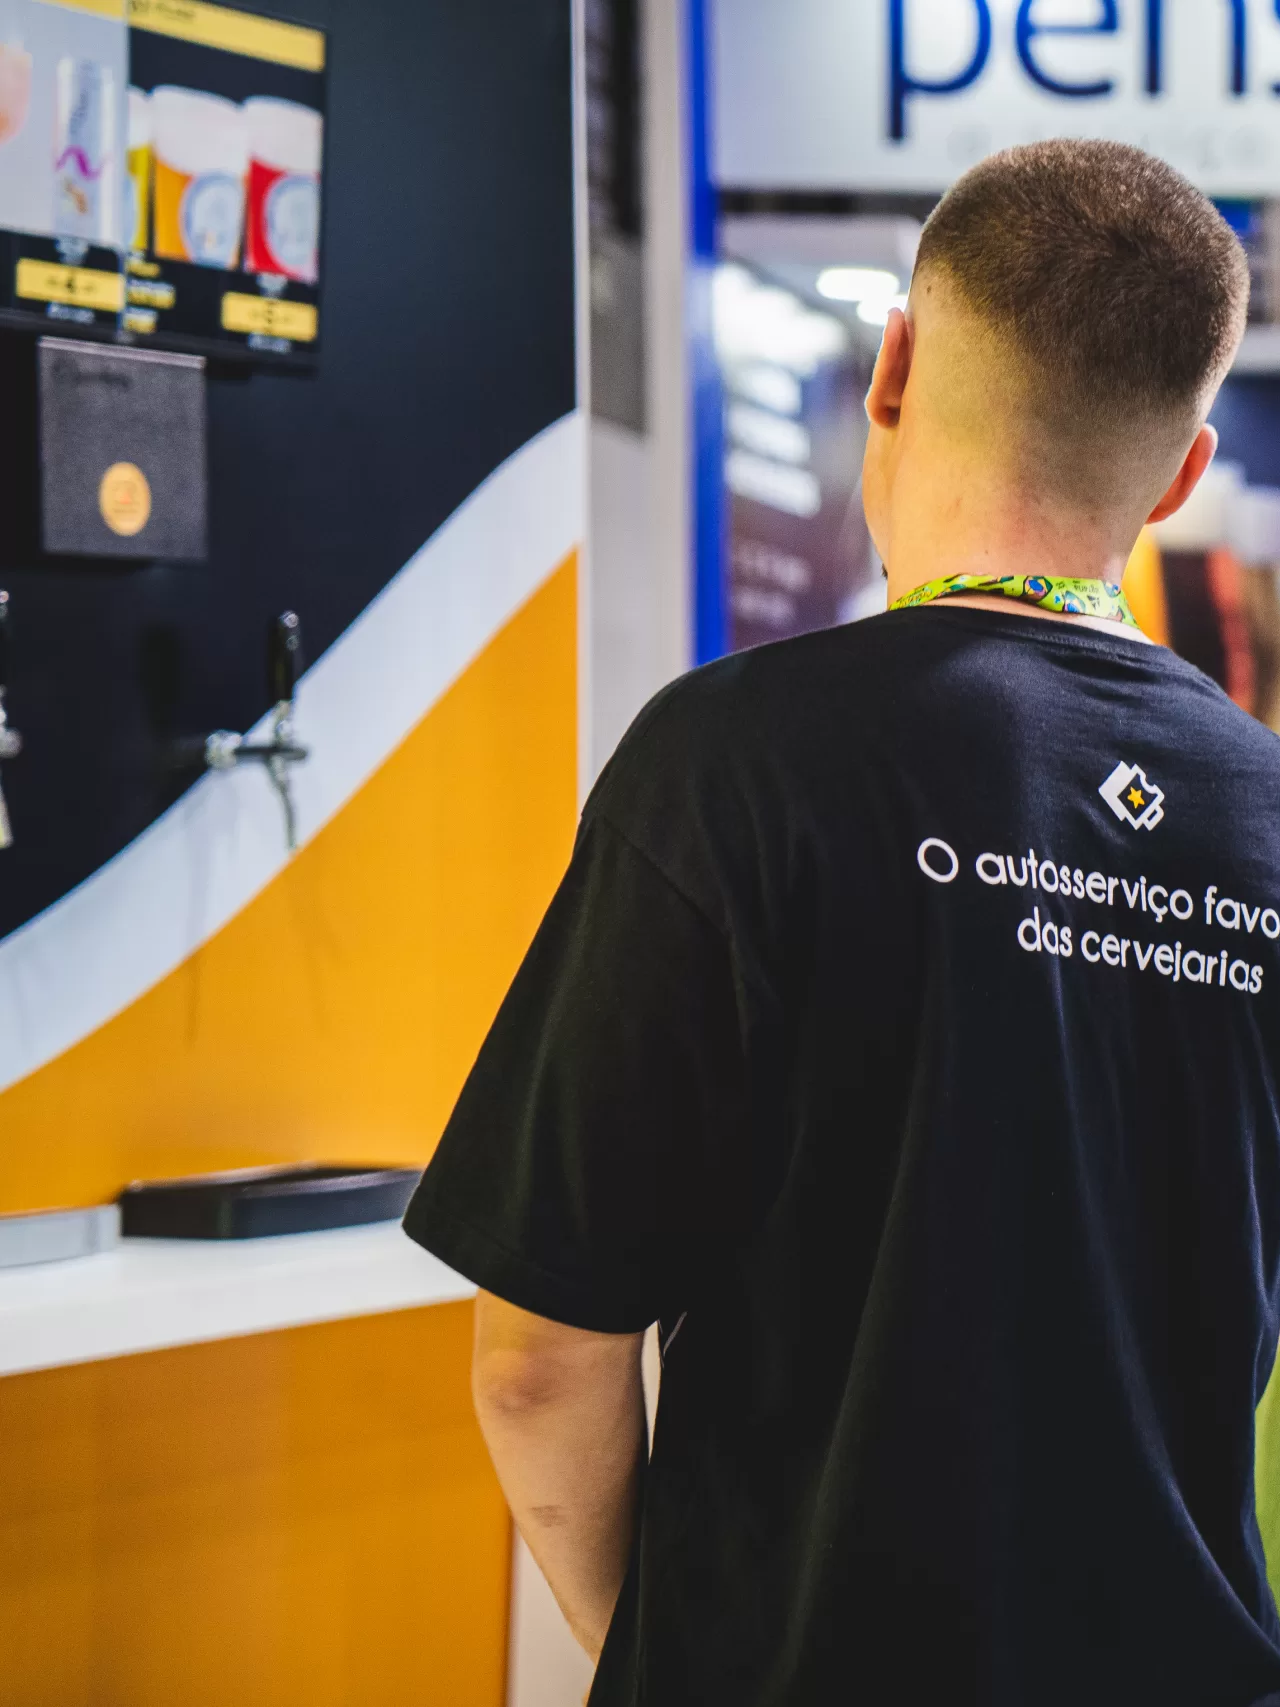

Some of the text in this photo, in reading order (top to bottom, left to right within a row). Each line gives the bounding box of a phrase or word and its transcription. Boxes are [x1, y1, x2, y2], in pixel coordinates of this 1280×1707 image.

[917, 837, 959, 883] O
[975, 848, 1194, 923] autosserviço
[1017, 906, 1264, 994] das cervejarias
